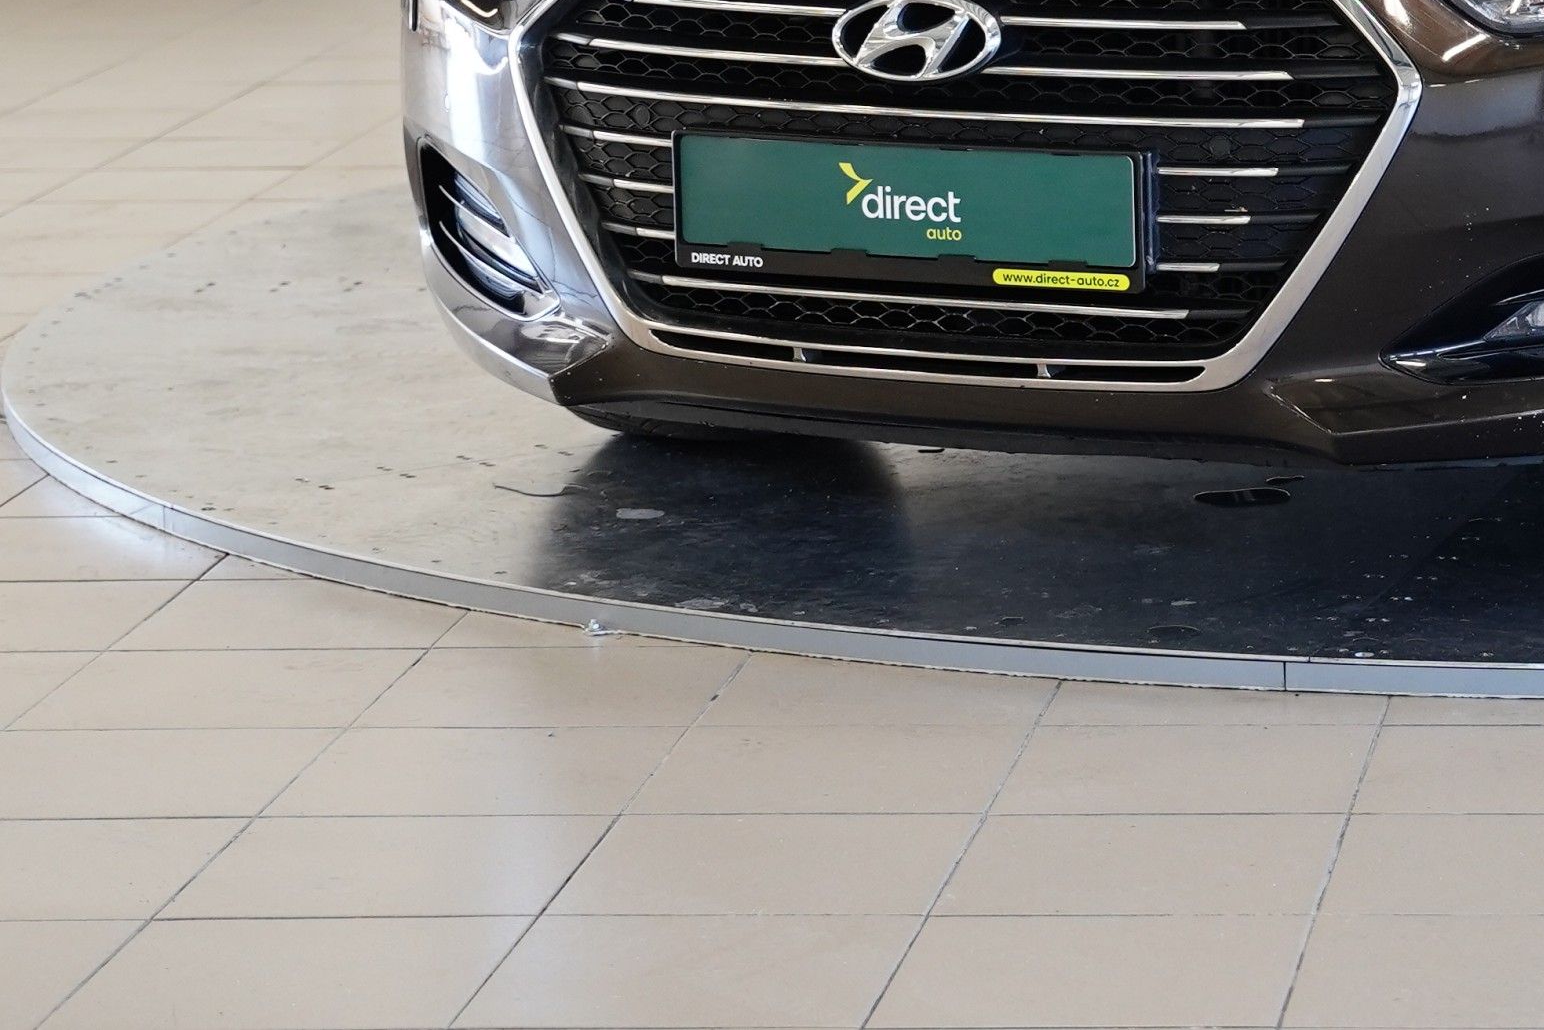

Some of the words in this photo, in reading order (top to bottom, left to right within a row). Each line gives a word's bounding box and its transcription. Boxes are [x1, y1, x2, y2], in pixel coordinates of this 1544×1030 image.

[861, 185, 962, 223] direct
[926, 226, 962, 241] auto
[691, 252, 731, 266] DIRECT
[732, 255, 764, 268] AUTO
[1002, 273, 1121, 288] www.direct-auto.cz
